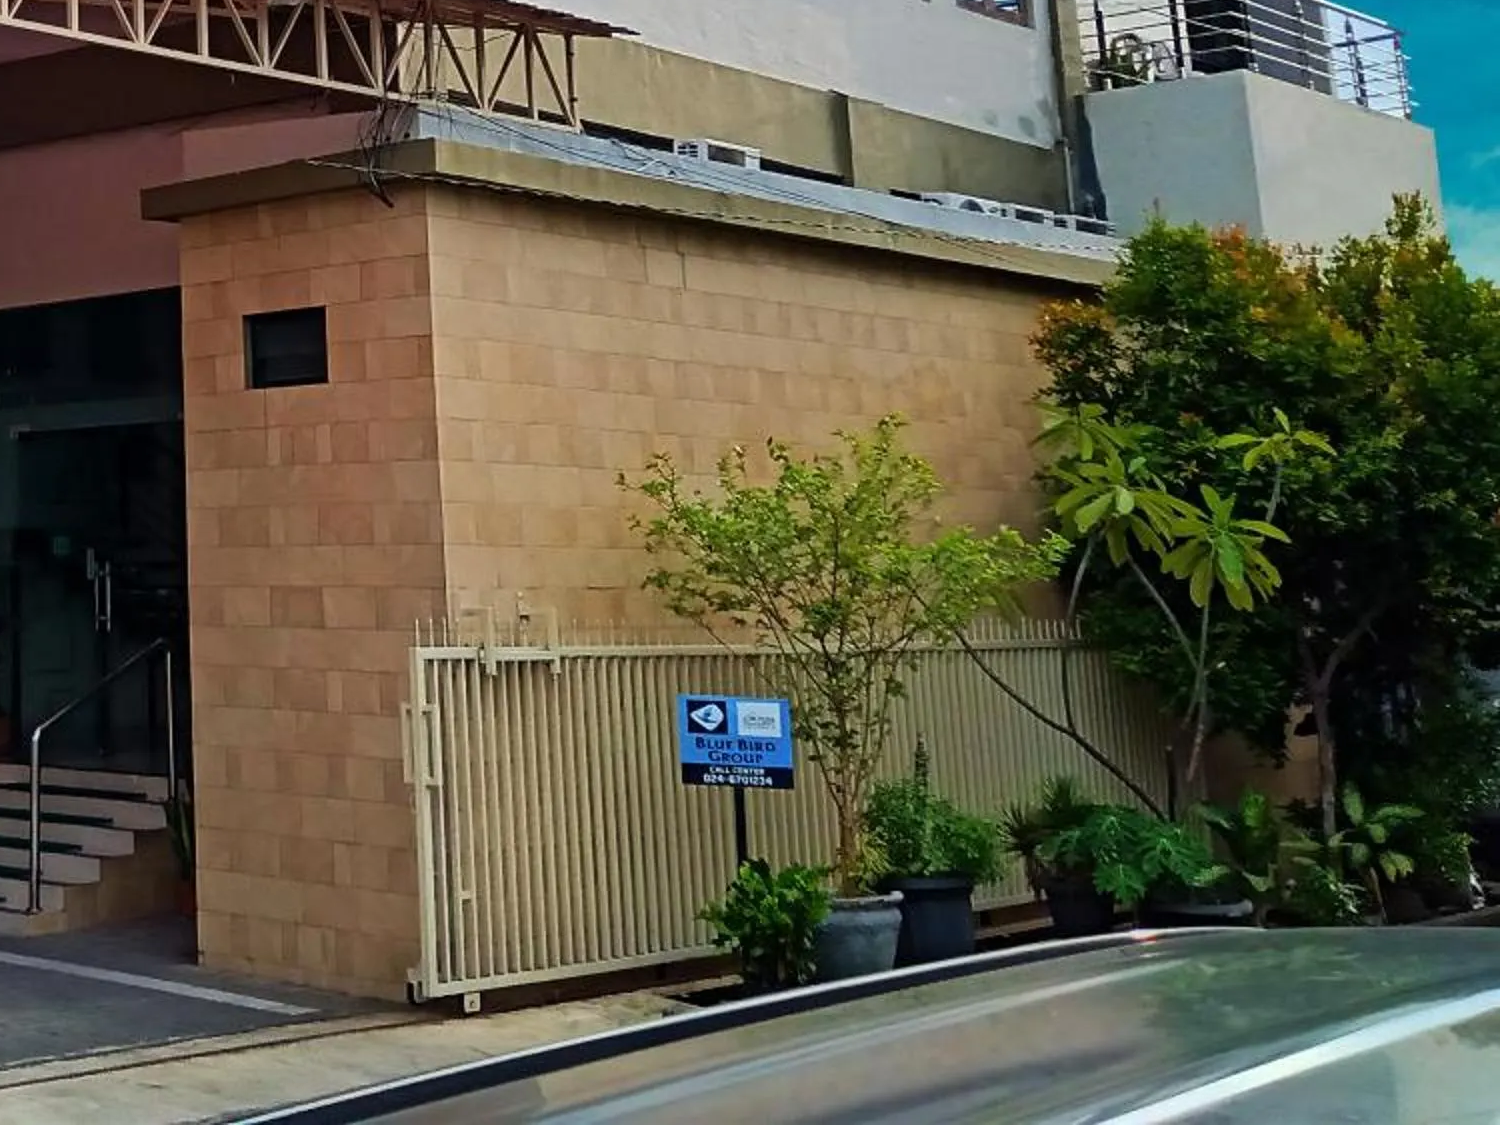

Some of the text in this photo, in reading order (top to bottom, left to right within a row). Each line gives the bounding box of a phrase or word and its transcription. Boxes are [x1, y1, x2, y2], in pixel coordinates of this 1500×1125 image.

[695, 737, 776, 752] BLUE BIRD
[708, 750, 764, 764] GROUP
[709, 766, 730, 774] CALL
